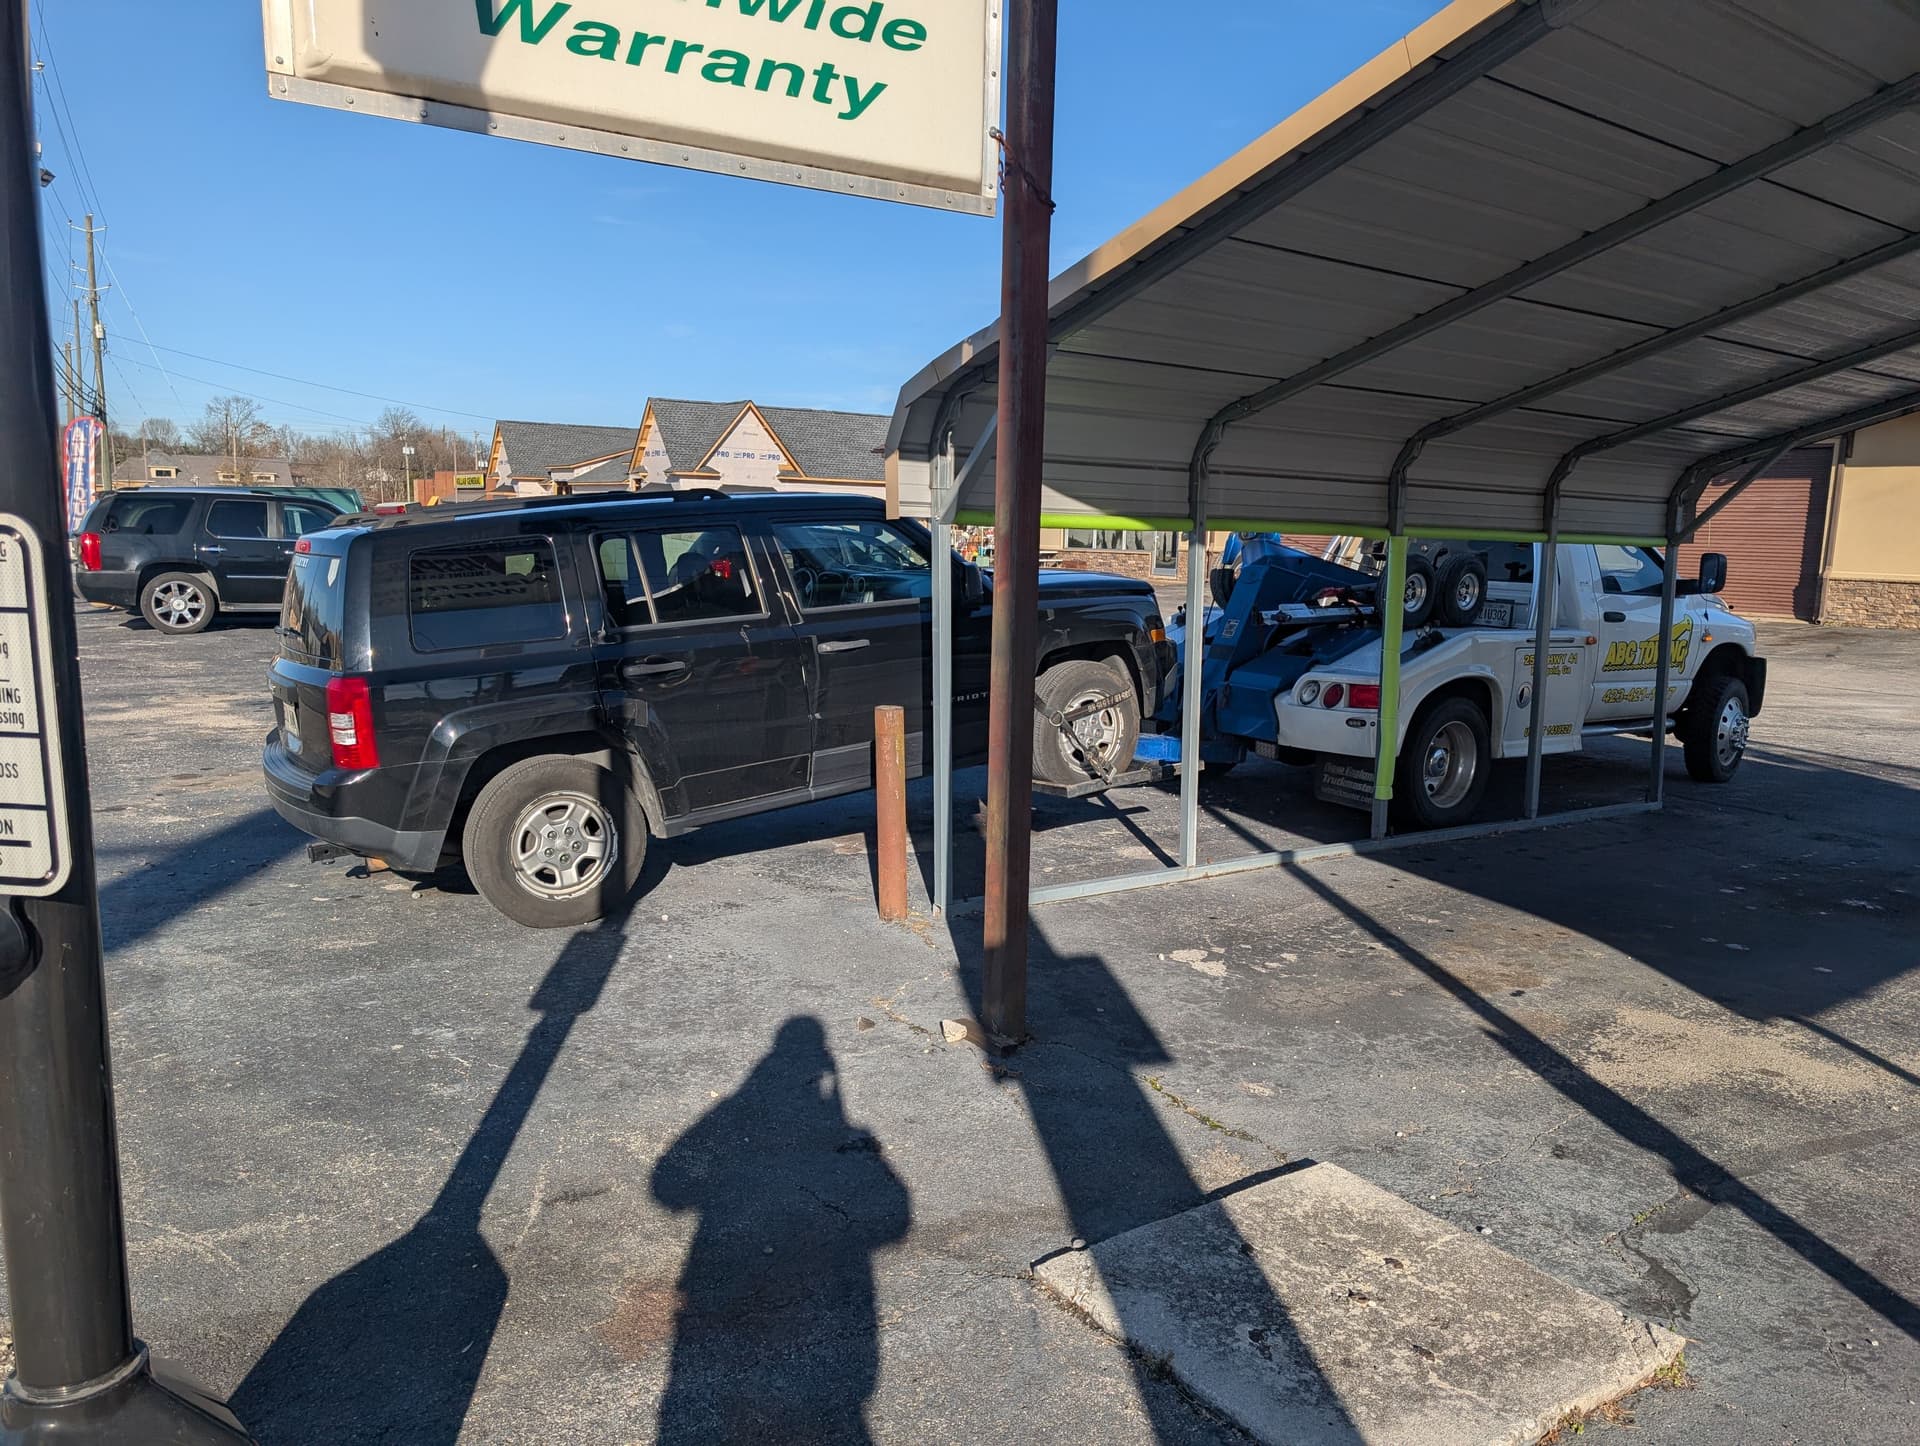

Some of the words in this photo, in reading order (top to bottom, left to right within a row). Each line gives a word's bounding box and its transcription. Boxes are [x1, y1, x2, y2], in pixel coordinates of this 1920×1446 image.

[473, 0, 889, 120] Warranty
[1604, 641, 1637, 666] ABC
[1638, 639, 1688, 667] TONG
[0, 687, 21, 704] ING
